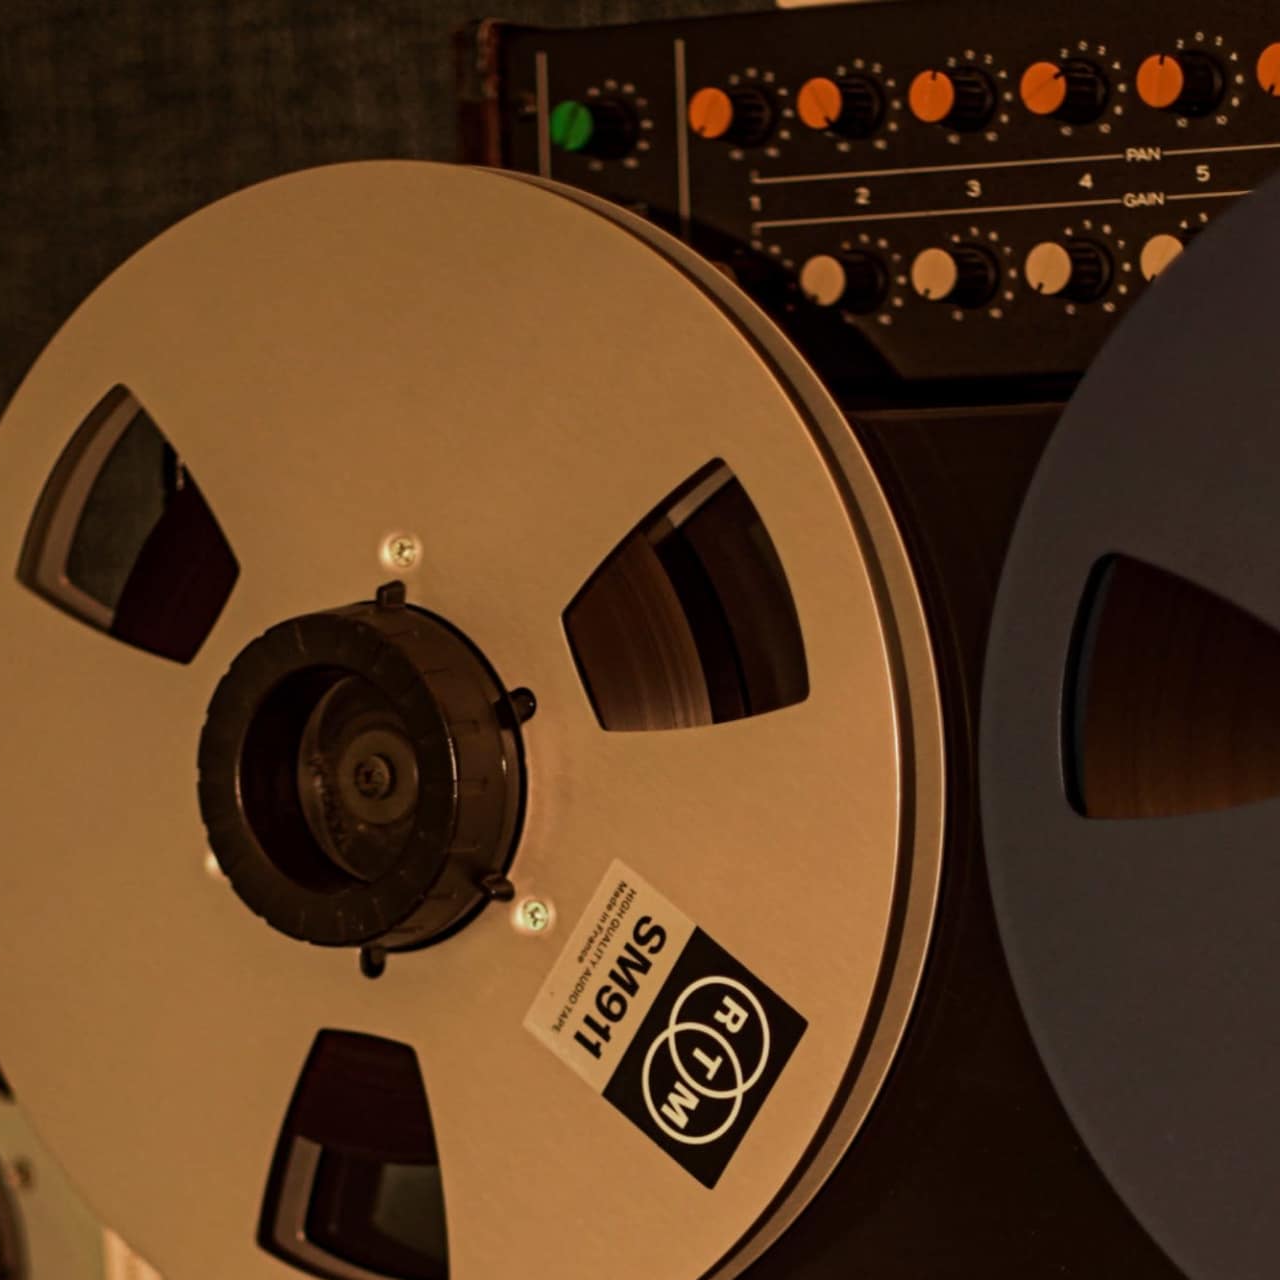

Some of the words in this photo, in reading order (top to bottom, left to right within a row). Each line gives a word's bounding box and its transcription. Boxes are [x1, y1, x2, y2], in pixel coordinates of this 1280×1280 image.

[1125, 146, 1162, 162] PAN
[853, 186, 871, 205] 2
[965, 178, 982, 198] 3
[1078, 172, 1094, 190] 4
[1195, 164, 1211, 182] 5
[1123, 191, 1165, 208] GAIN
[606, 881, 628, 911] Made
[617, 888, 637, 919] HIGH
[577, 923, 603, 964] France
[590, 918, 620, 968] QUALITY
[569, 967, 592, 1004] AUDIO
[574, 915, 667, 1059] SM911
[551, 1005, 572, 1033] TAPE
